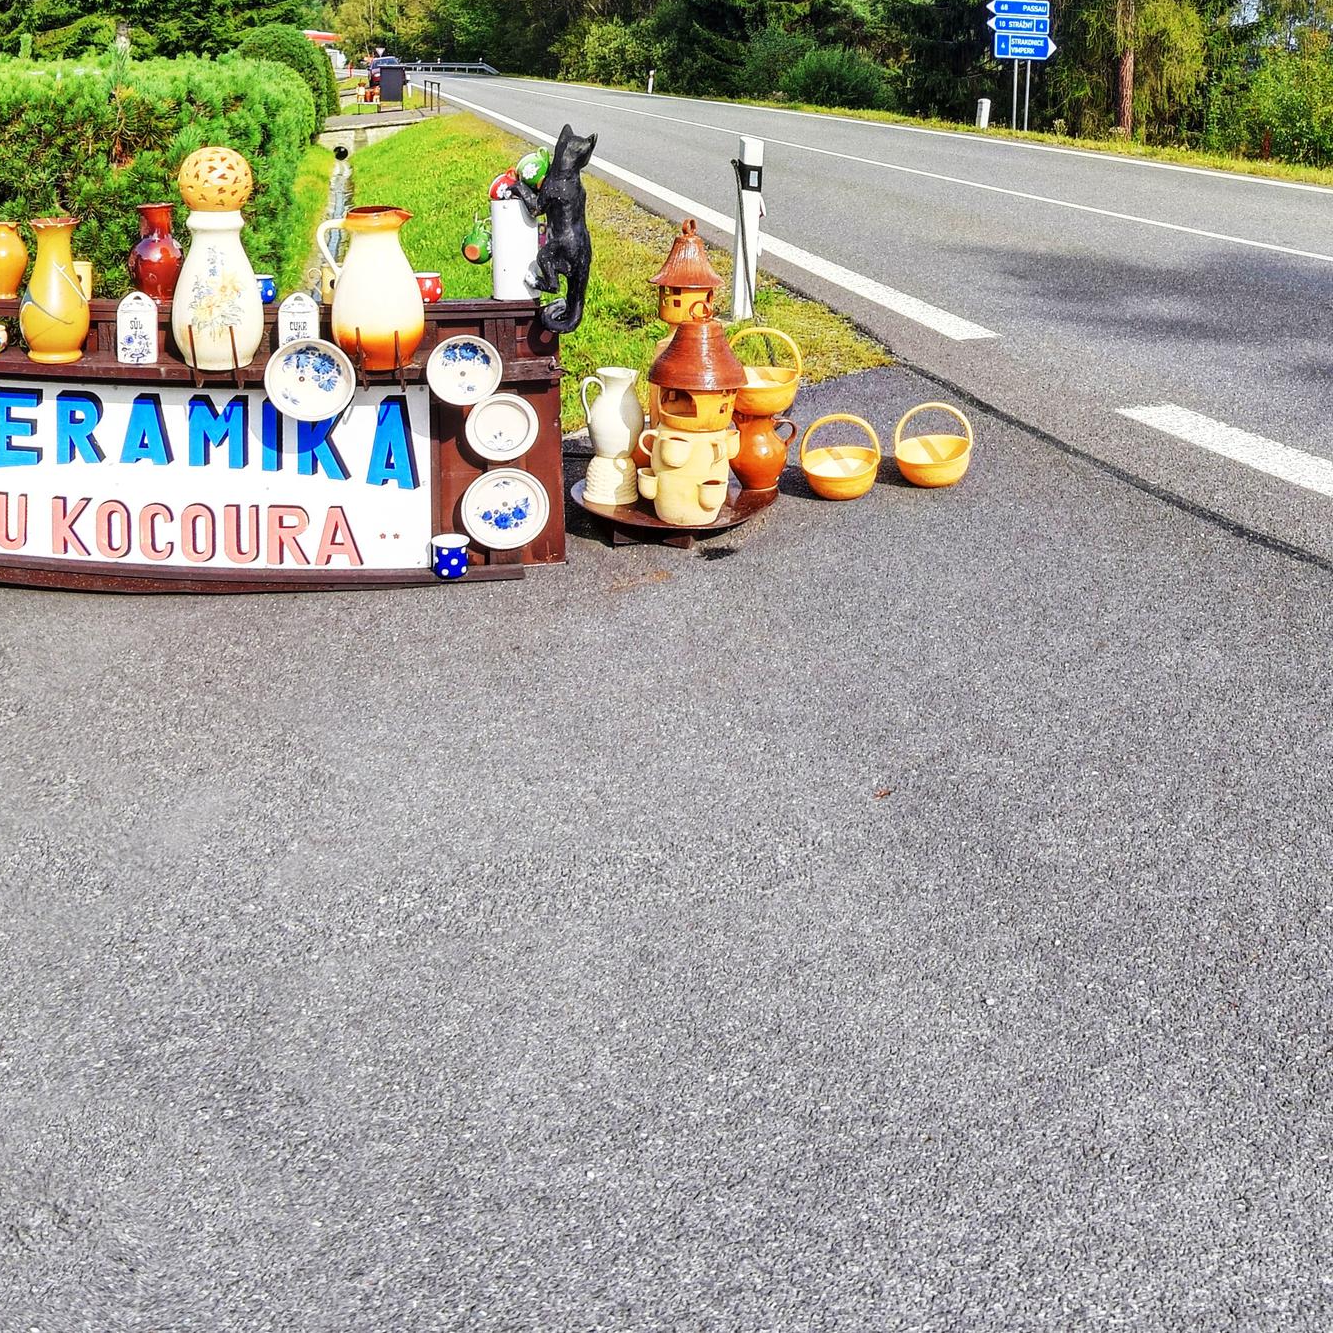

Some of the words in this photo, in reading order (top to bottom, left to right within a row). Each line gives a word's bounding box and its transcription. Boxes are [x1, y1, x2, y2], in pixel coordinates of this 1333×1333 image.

[1011, 38, 1044, 46] STRAKONICE
[289, 321, 308, 331] CUKR
[52, 496, 364, 566] KOCOURA
